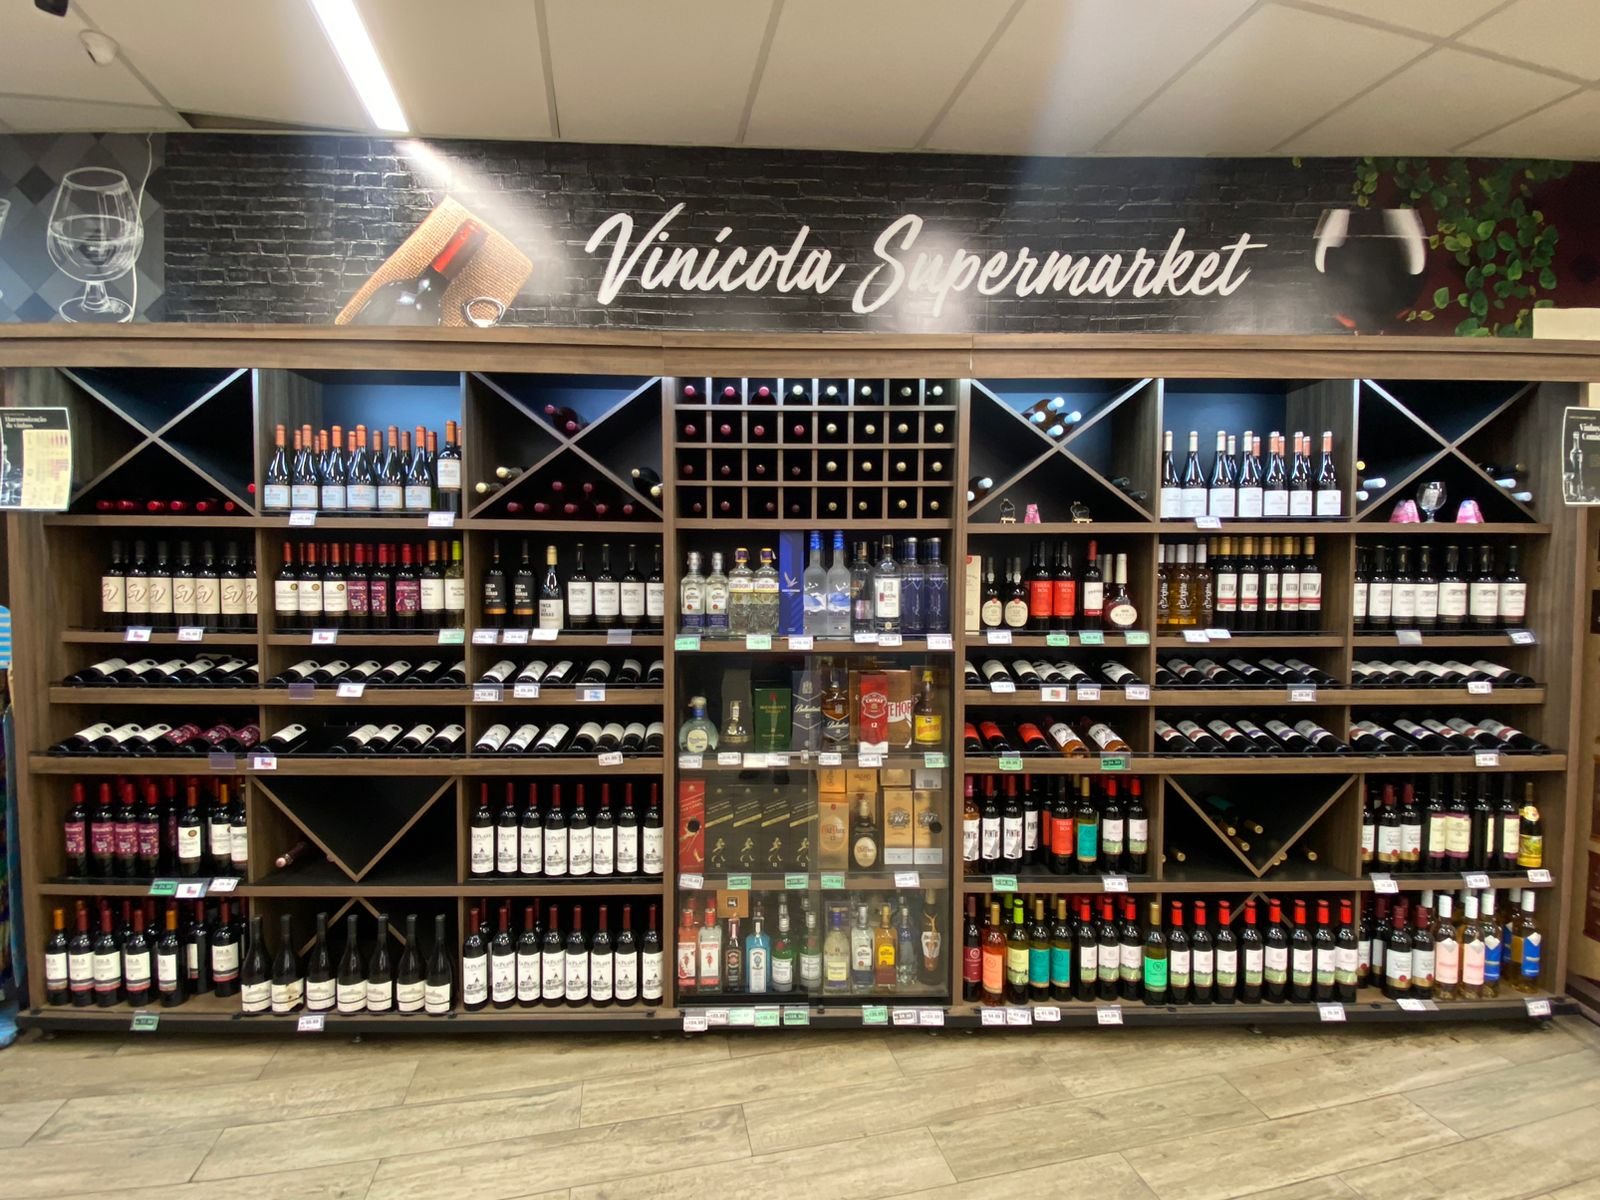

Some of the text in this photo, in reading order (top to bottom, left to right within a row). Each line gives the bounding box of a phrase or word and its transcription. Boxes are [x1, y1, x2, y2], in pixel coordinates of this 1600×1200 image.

[585, 202, 1267, 318] Vinícola Supermarket
[128, 583, 148, 602] SV
[175, 584, 195, 604] SV
[223, 585, 244, 605] SV
